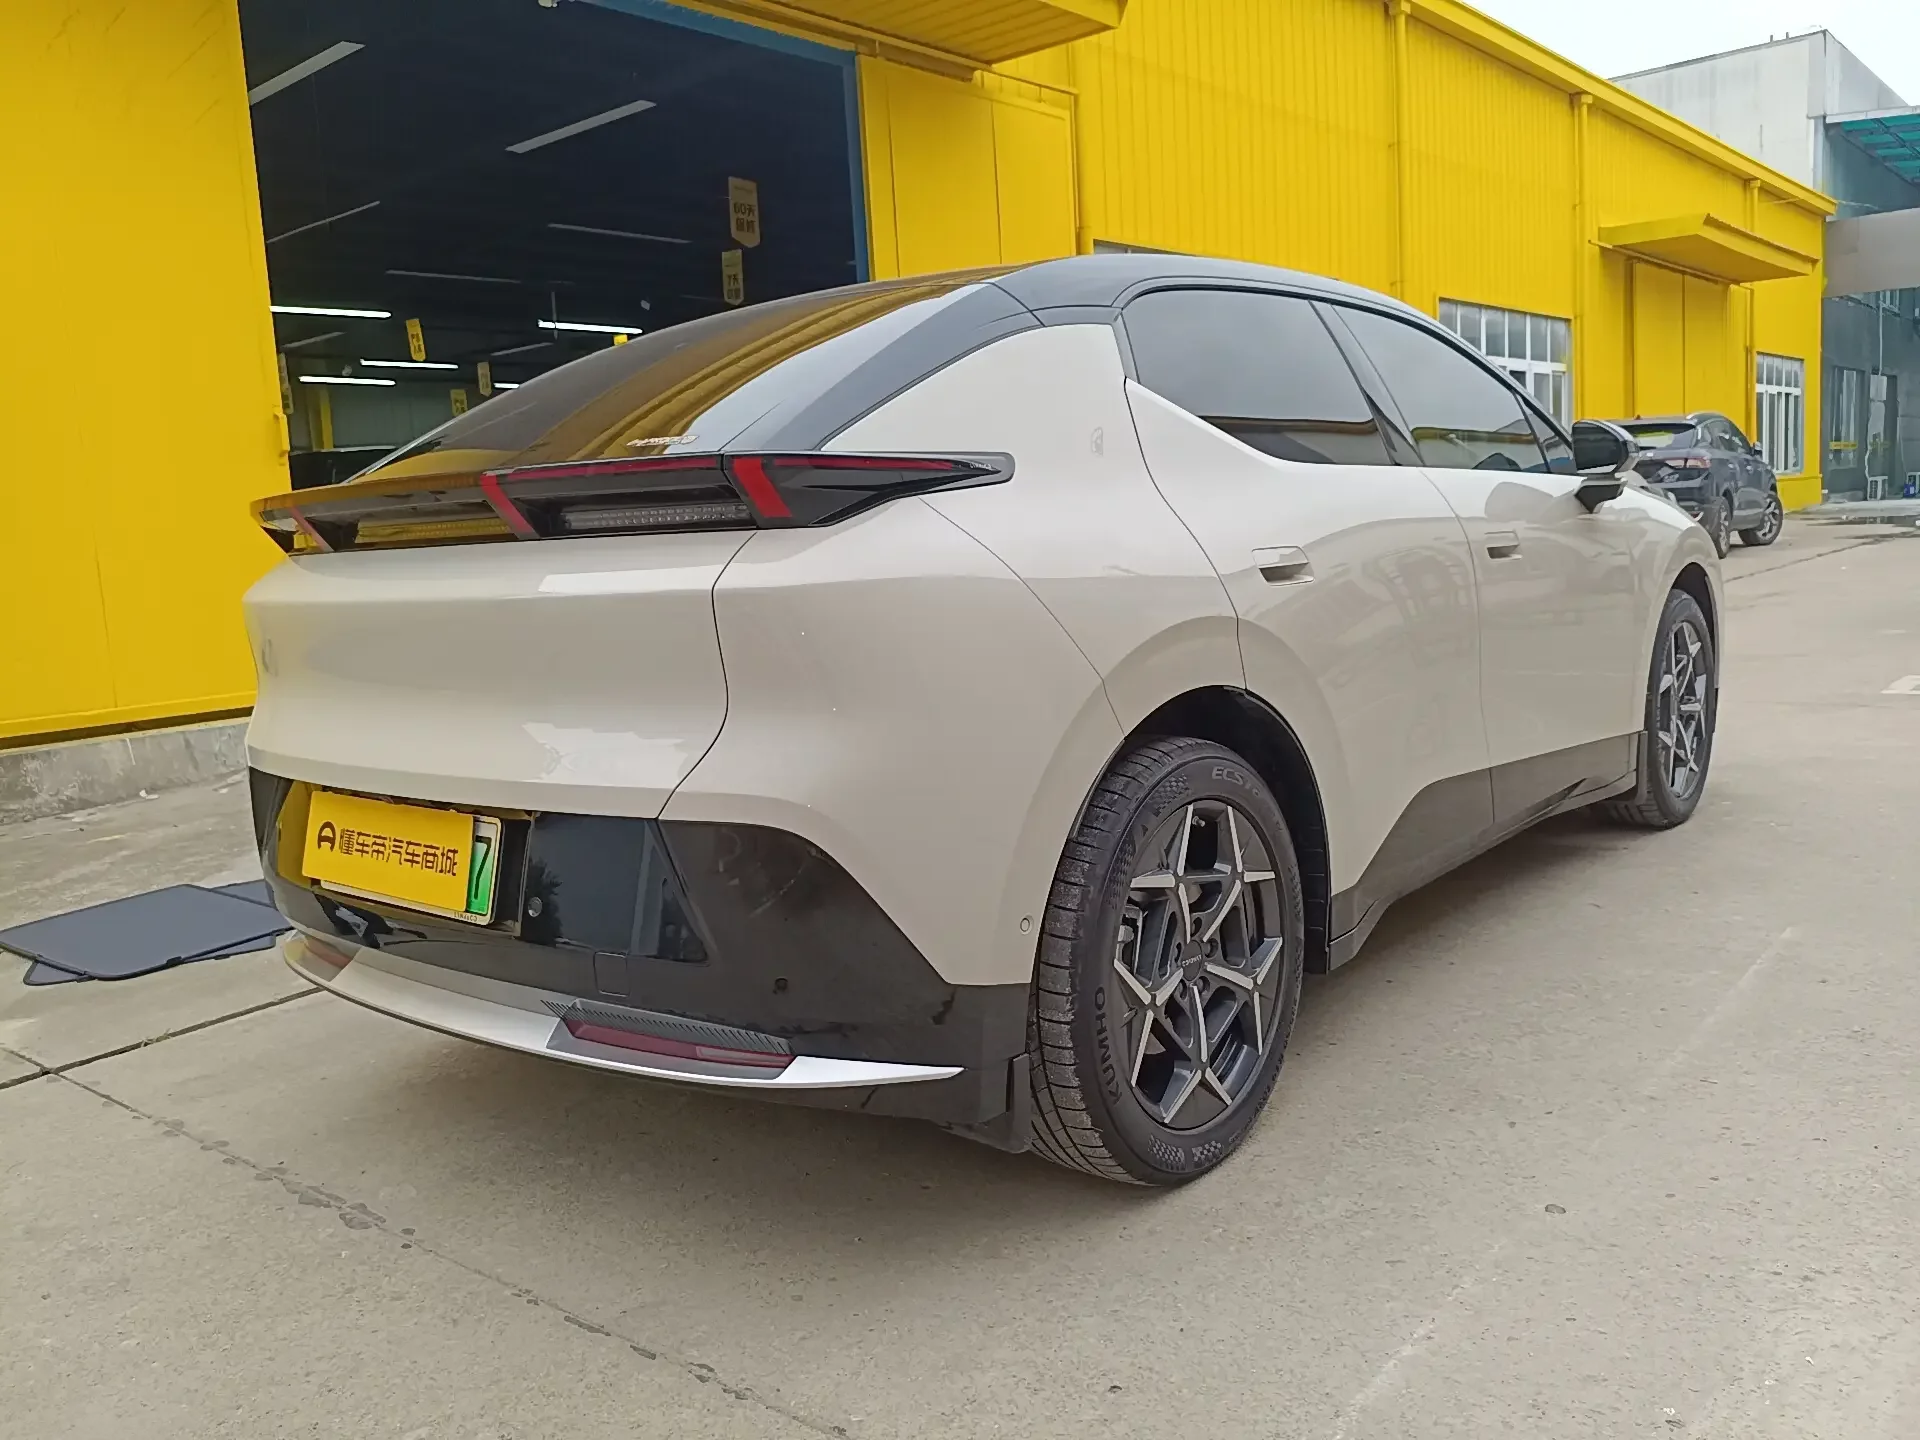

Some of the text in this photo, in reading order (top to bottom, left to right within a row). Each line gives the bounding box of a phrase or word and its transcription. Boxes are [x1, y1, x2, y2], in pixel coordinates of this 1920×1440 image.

[339, 827, 459, 877] 懂车帝汽车商城
[475, 835, 493, 899] 7
[1094, 985, 1123, 1107] KUMHO
